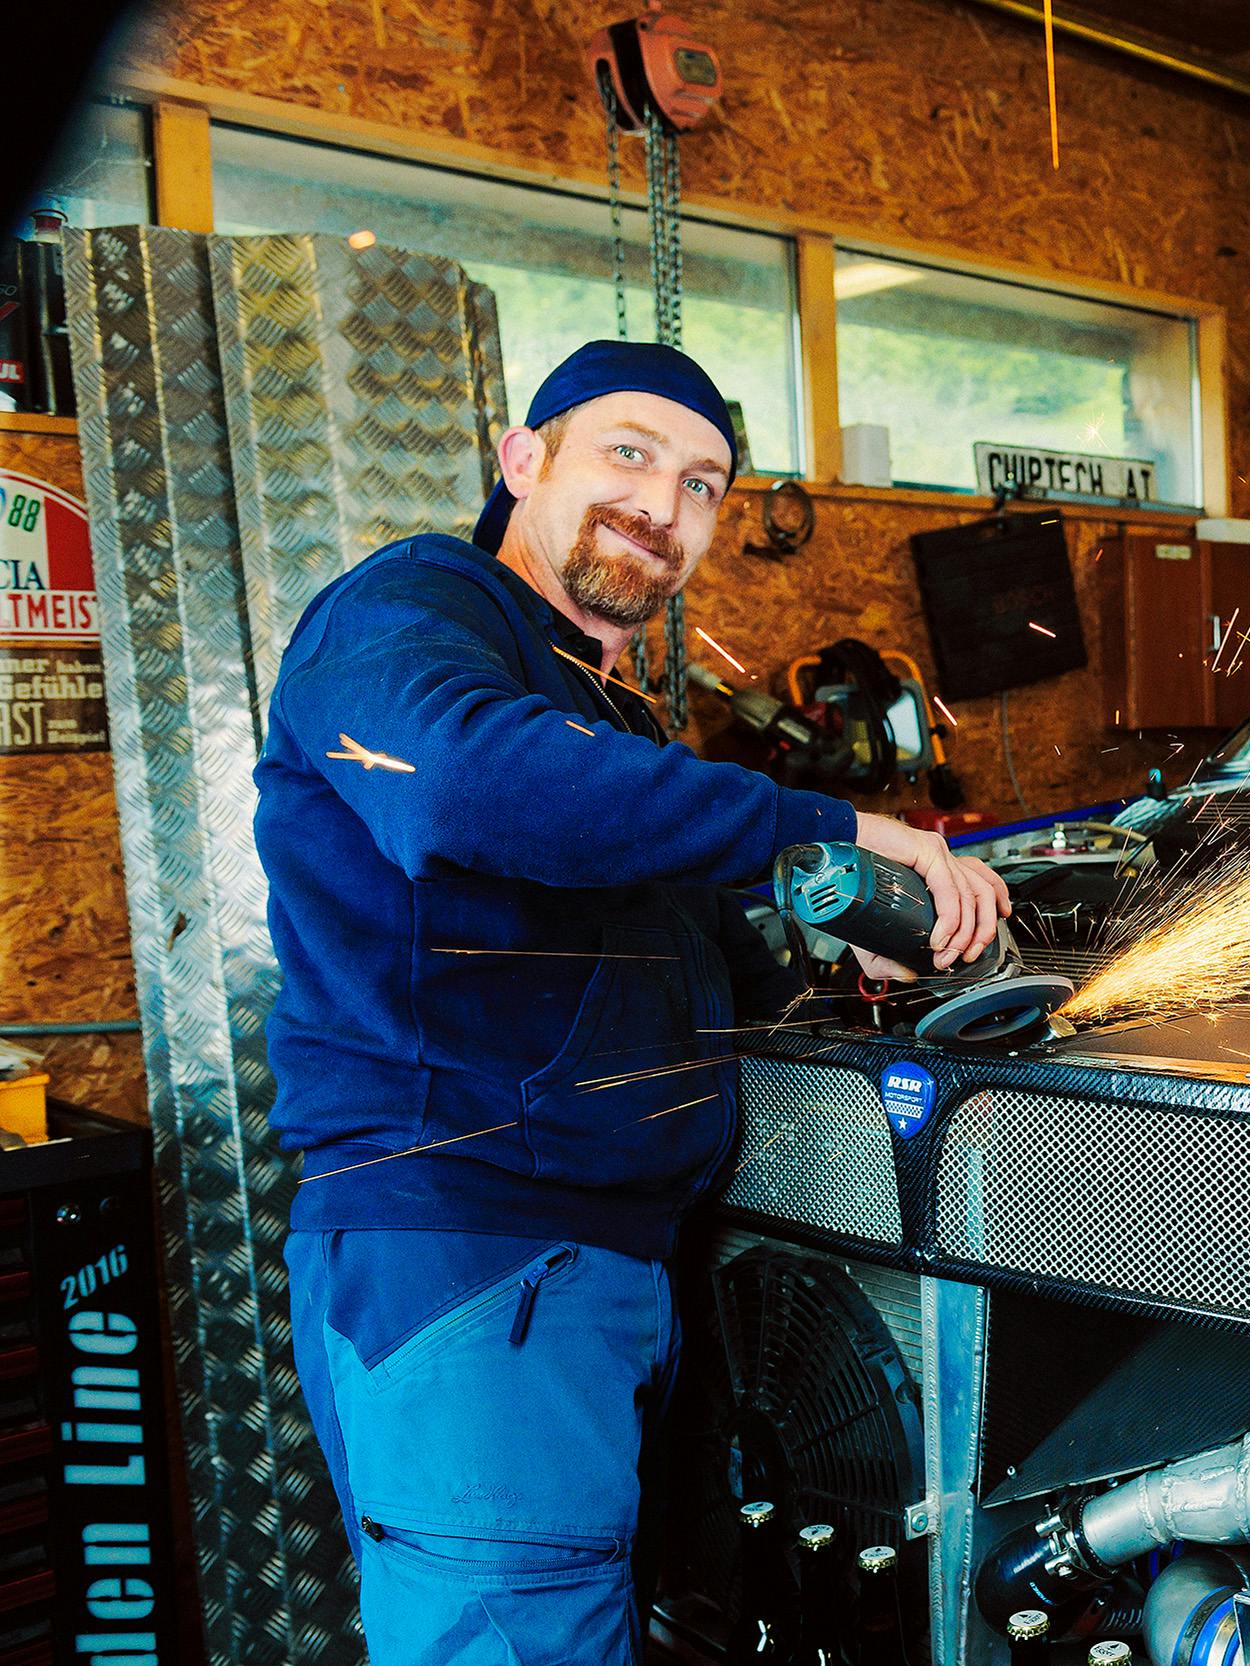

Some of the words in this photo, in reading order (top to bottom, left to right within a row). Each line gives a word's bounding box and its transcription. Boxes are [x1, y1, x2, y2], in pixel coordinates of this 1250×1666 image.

[988, 452, 1104, 497] CHIPTECH
[1126, 467, 1151, 500] AT
[8, 594, 97, 628] TMEIS
[884, 1091, 923, 1103] MOTORSPORT
[887, 1075, 922, 1092] RSR
[60, 1244, 129, 1311] 2016
[60, 1310, 147, 1486] Line
